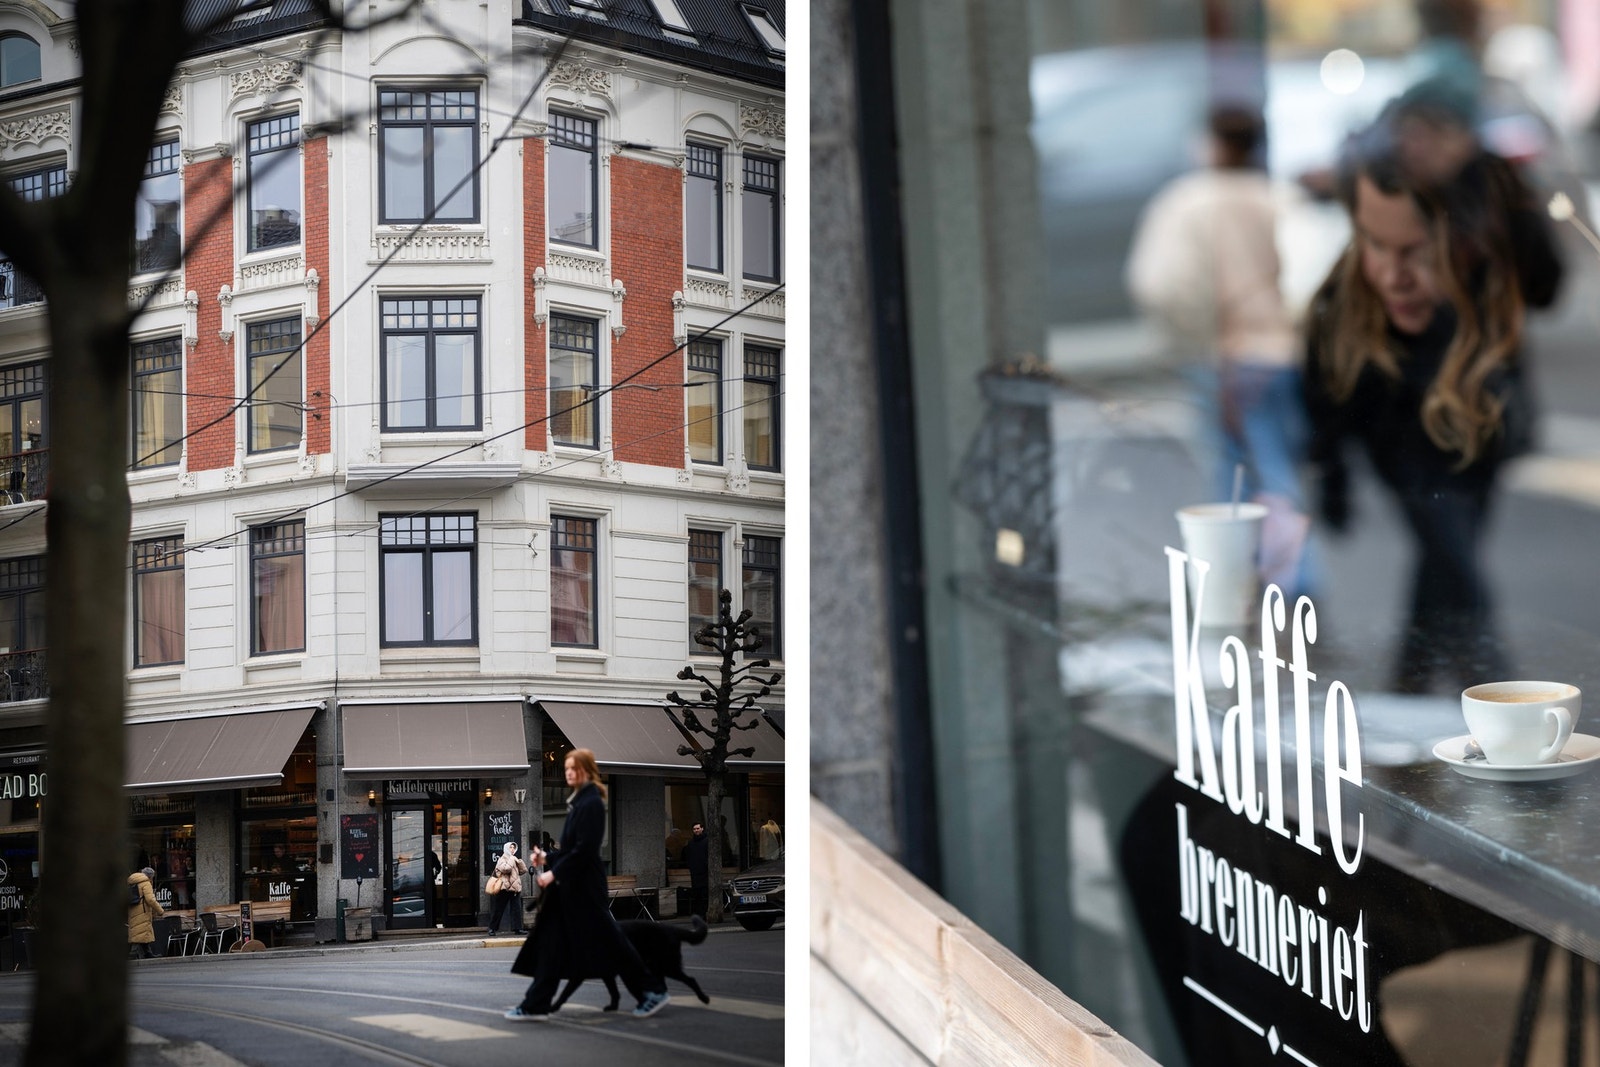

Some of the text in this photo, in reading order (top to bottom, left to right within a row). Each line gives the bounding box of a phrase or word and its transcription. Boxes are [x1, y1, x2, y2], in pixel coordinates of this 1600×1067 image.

[1164, 545, 1365, 876] Kaffe
[29, 772, 48, 797] BO
[153, 888, 172, 901] affe
[269, 882, 291, 895] Kaffe
[1175, 802, 1371, 1034] brenneriet
